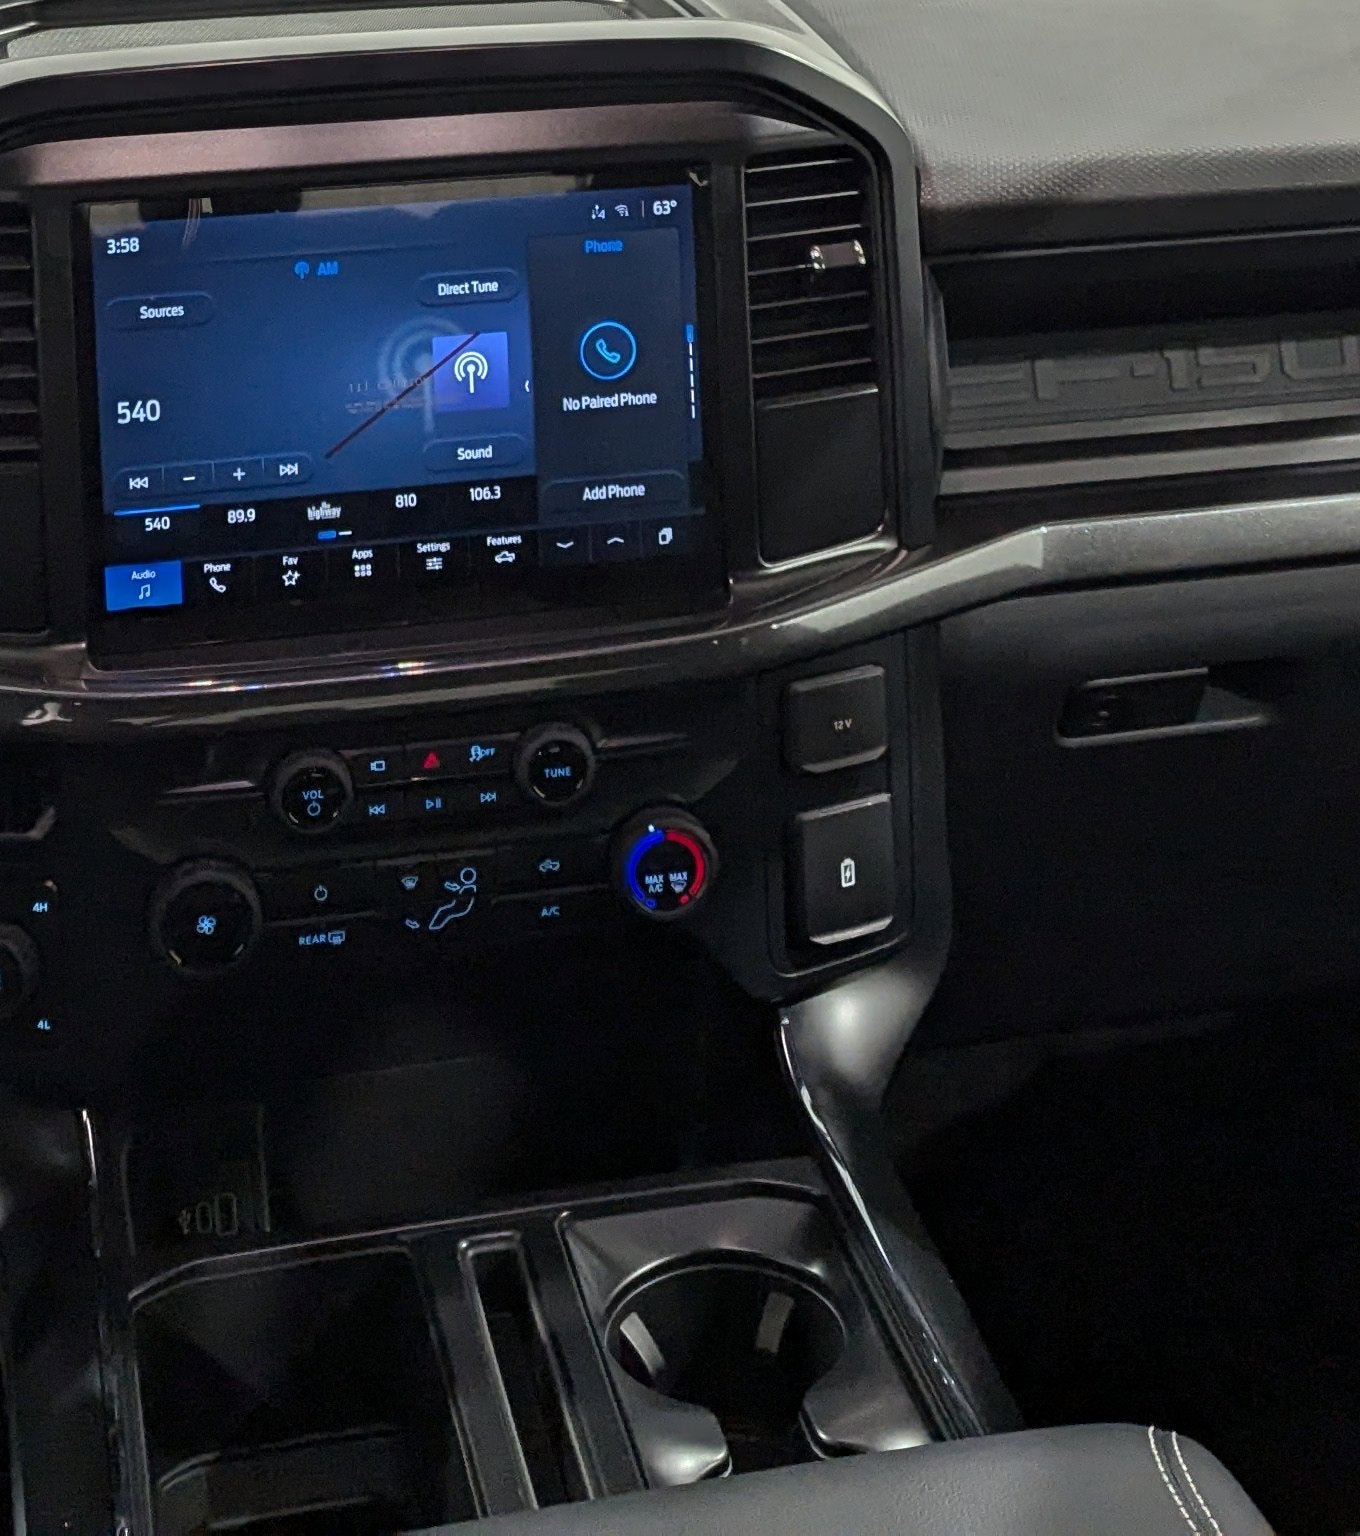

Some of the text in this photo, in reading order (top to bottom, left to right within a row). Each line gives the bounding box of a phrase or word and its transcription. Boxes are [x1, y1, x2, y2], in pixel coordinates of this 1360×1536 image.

[106, 238, 140, 254] 3:58
[585, 240, 624, 254] Phone
[317, 262, 338, 276] AM
[438, 280, 498, 296] Direct Tune
[140, 306, 184, 319] Sources
[1032, 334, 1360, 401] F-150
[563, 393, 657, 412] No Paired Phone
[116, 399, 161, 424] 540
[457, 445, 493, 460] Sound
[469, 486, 501, 501] 106.3
[583, 484, 645, 501] Add Phone
[395, 493, 417, 508] 810
[227, 508, 256, 524] 89.9
[144, 517, 170, 532] 540
[416, 540, 450, 554] Settings
[486, 534, 522, 547] Features
[352, 548, 373, 560] Apps
[203, 561, 231, 573] Phone
[283, 556, 298, 566] Fav
[131, 569, 156, 580] Audio
[480, 746, 496, 758] OFF
[544, 767, 572, 778] TUNE
[302, 790, 324, 800] VOL
[644, 874, 664, 884] MAX
[669, 872, 688, 882] MAX
[648, 883, 663, 893] A/C
[32, 902, 48, 913] 4H
[540, 905, 562, 918] A/C
[299, 933, 326, 945] REAR
[36, 1019, 51, 1030] 4L
